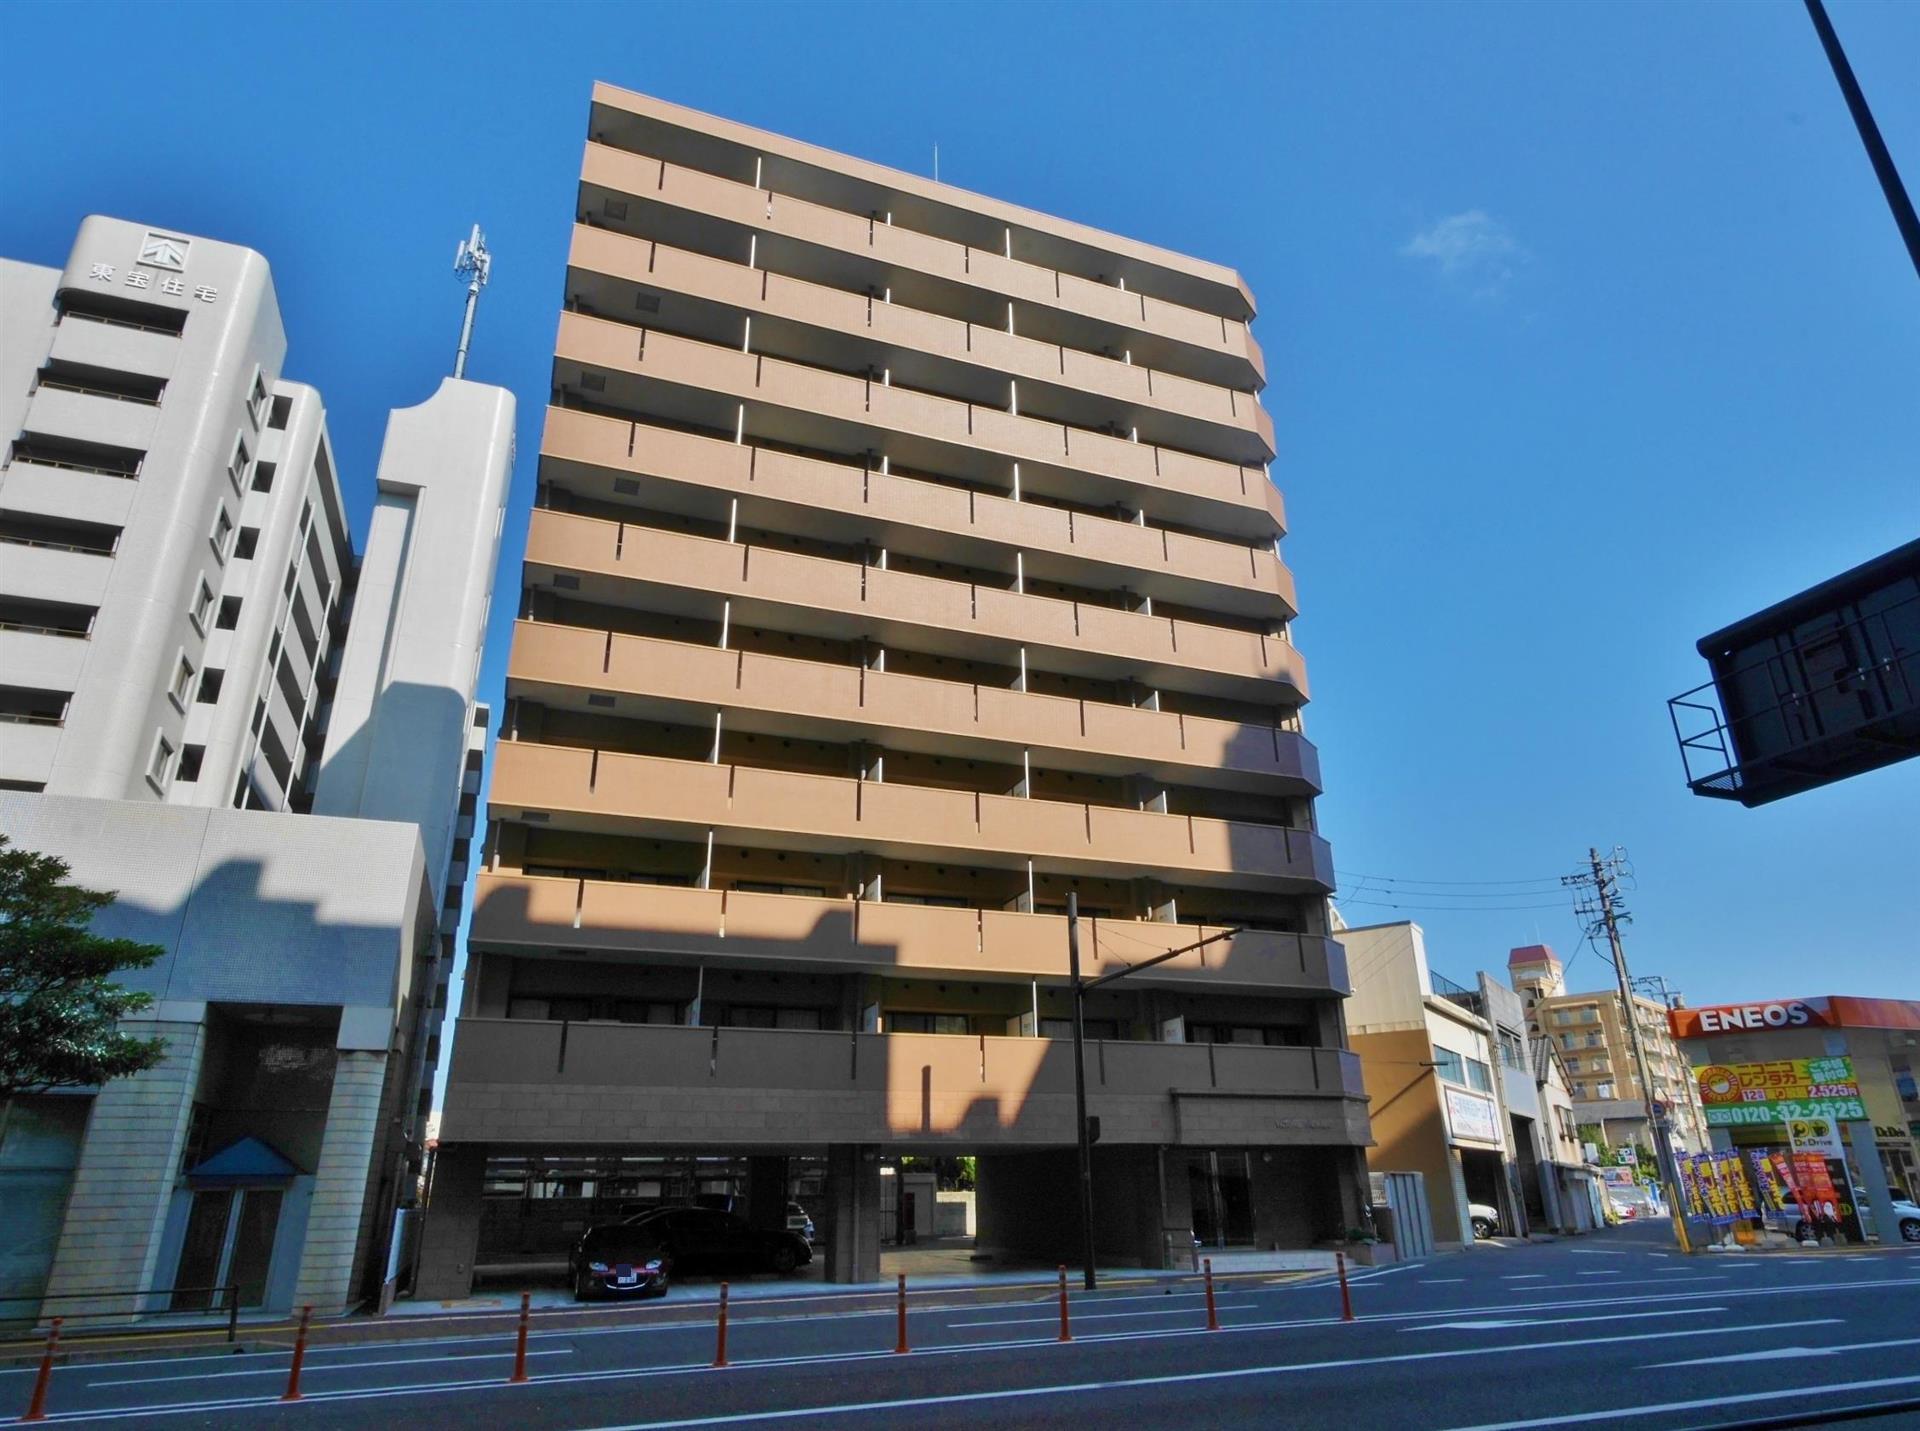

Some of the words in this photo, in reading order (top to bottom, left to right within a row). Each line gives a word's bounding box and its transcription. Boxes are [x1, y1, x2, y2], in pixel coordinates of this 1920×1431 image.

[89, 262, 217, 303] 東宝住宅
[1701, 1004, 1809, 1032] ENEOS
[1736, 1061, 1795, 1076] ニコニコ
[1739, 1073, 1811, 1087] レンタカー
[1731, 1101, 1864, 1123] 0120-32-2525
